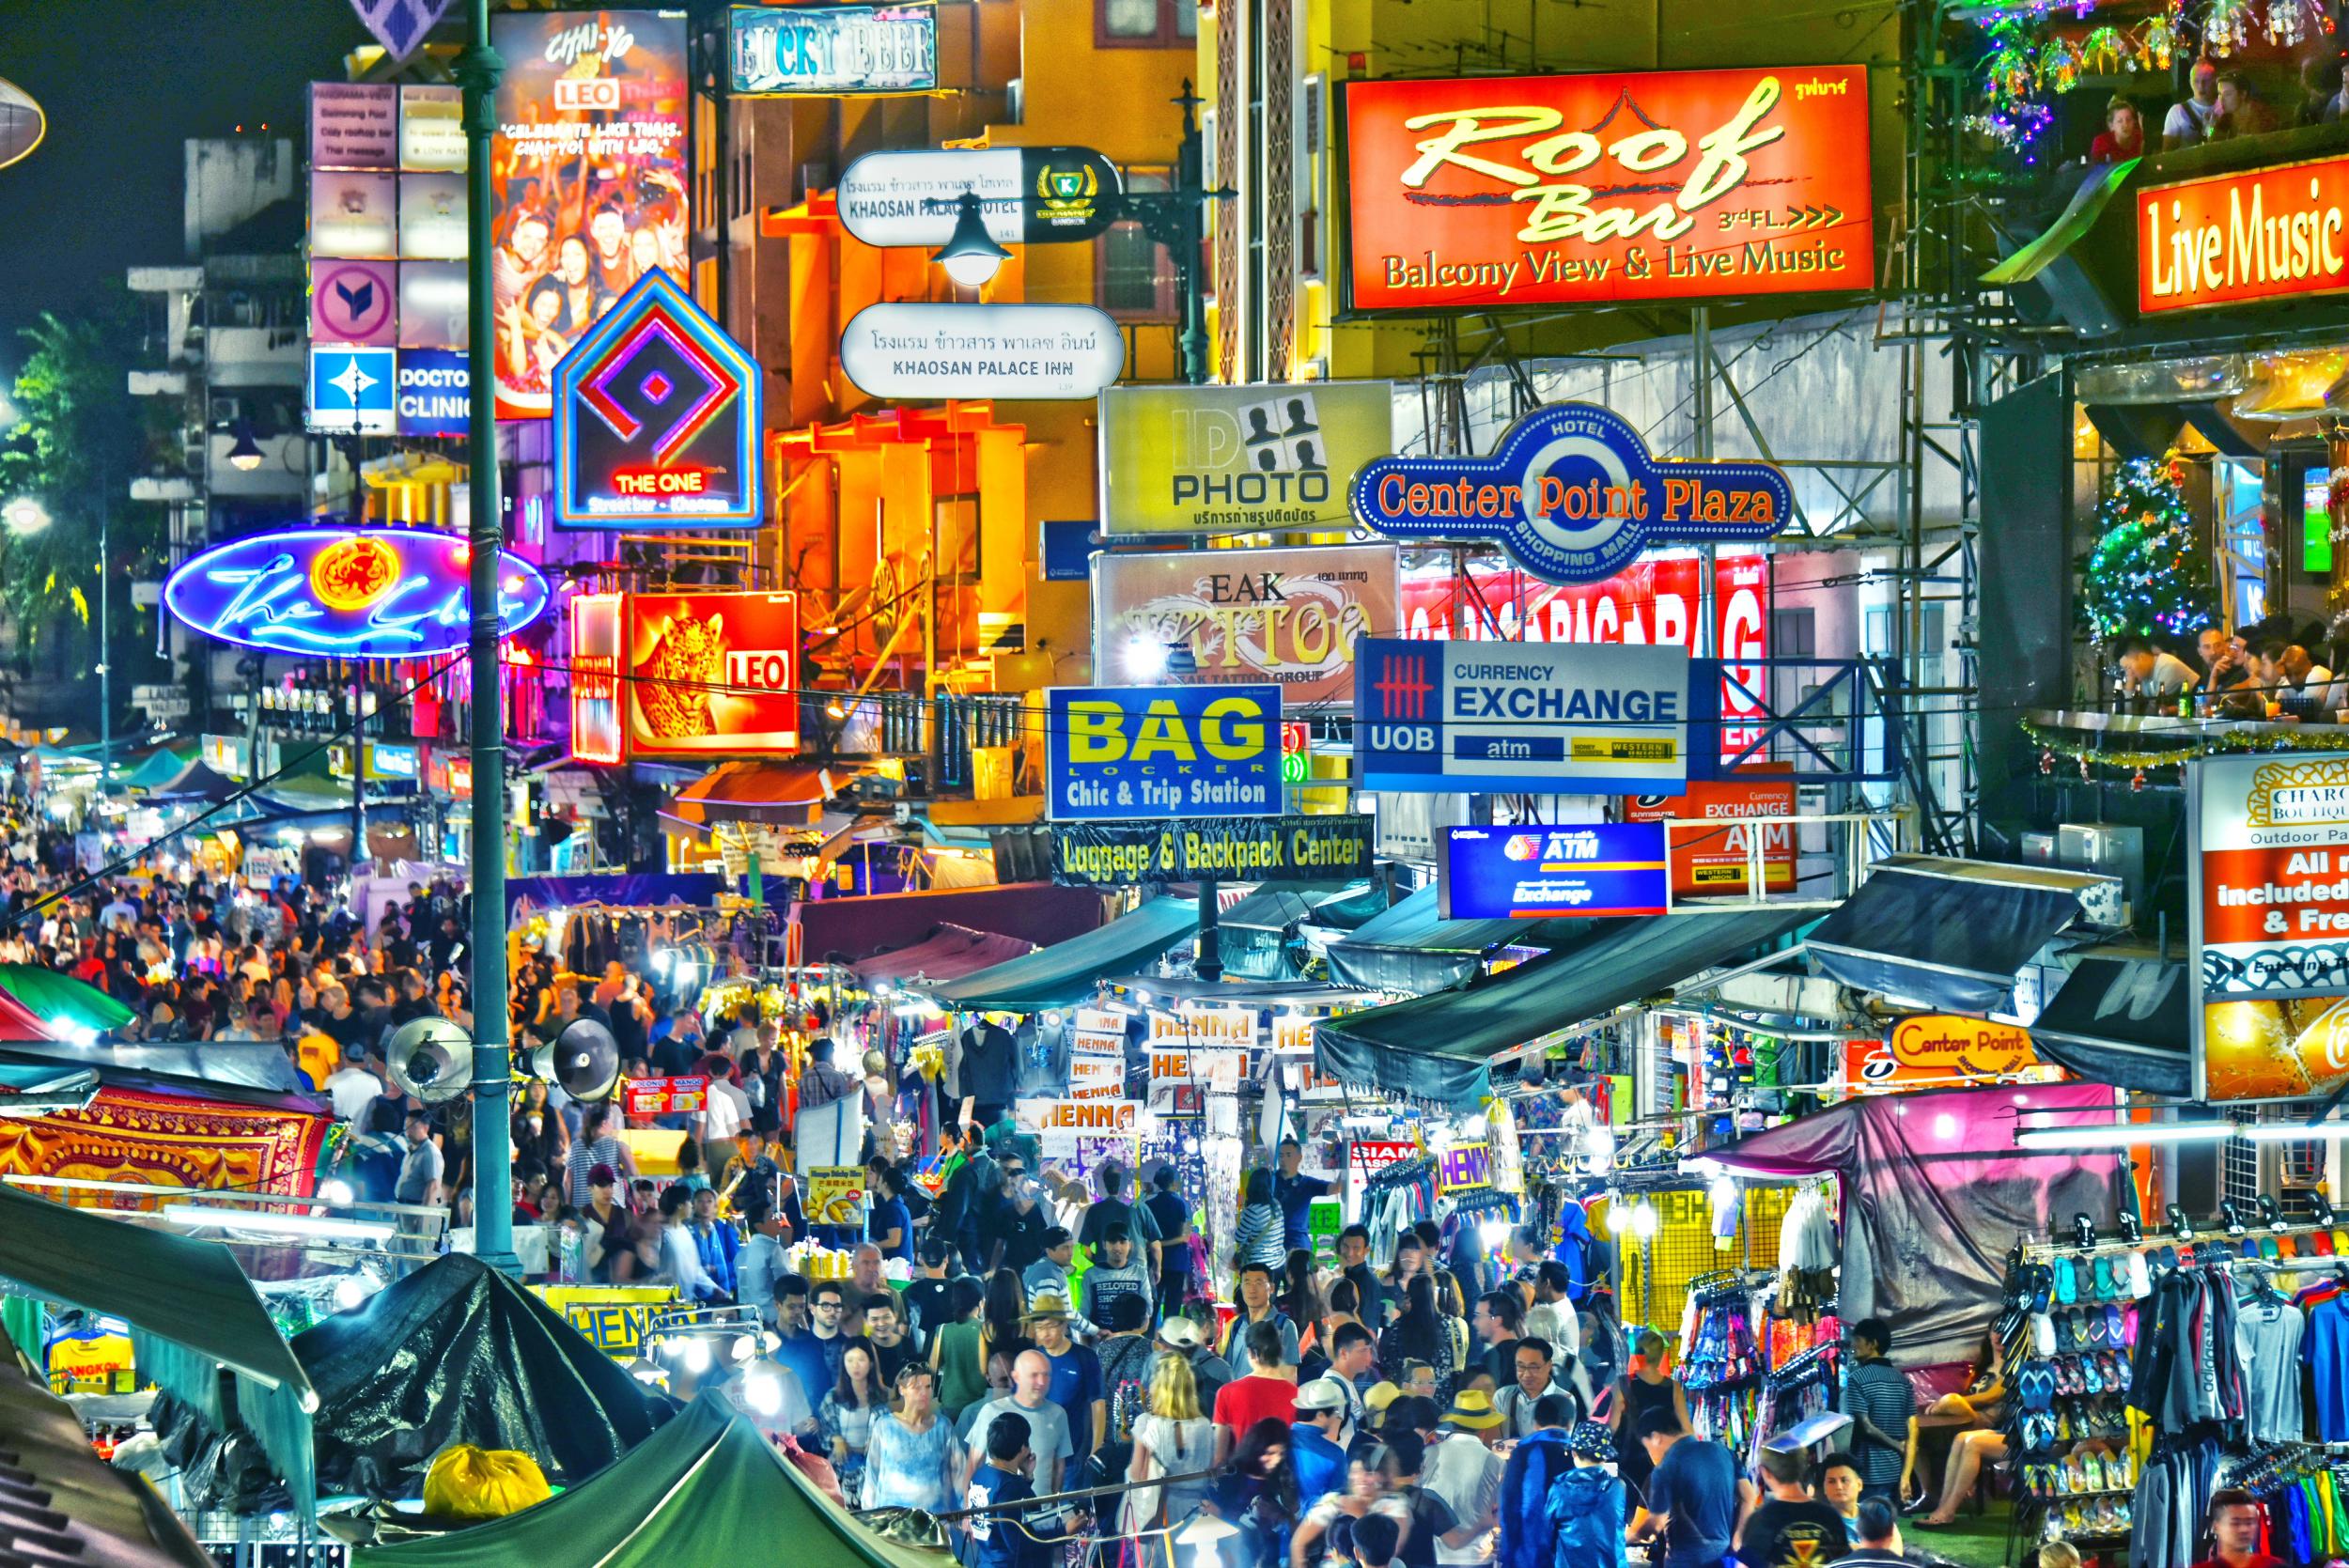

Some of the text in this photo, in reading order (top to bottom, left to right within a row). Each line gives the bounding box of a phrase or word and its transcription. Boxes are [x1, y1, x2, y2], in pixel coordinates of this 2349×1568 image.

[545, 23, 634, 65] CHAI-YO
[735, 23, 933, 77] LUCKY BEER
[560, 84, 614, 104] LEO
[596, 123, 630, 137] LIKE
[588, 140, 624, 155] WITH
[1401, 76, 1784, 211] Roof
[1061, 179, 1073, 193] K
[849, 200, 914, 218] KHAOSAN
[1513, 185, 1695, 244] Bar
[2148, 178, 2344, 297] Live Music
[1383, 240, 1844, 294] Balcony View & Live Music
[871, 331, 927, 350] โรงแรม
[935, 331, 995, 350] ข้าวสาร
[400, 368, 470, 387] DOCTO
[894, 361, 1073, 376] KHAOSAN PALACE INN
[1550, 419, 1606, 439] HOTEL
[615, 473, 703, 493] THE ONE
[1173, 471, 1330, 505] PHOTO
[1378, 474, 1774, 523] Center Point Plaza
[1516, 520, 1641, 567] SHOPPING MALL
[207, 554, 324, 633] The
[1209, 572, 1287, 602] EAK
[731, 655, 786, 690] LEO
[1209, 674, 1270, 684] TATTOO
[1273, 671, 1324, 683] GROUP
[1455, 663, 1554, 681] CURRENCY
[1454, 686, 1677, 721] EXCHANGE
[1068, 697, 1265, 763] BAG
[1371, 725, 1435, 751] UOB
[1487, 740, 1531, 758] atm
[1068, 764, 1265, 777] LOCKER
[1066, 777, 1266, 811] Chic & Trip Station
[1750, 792, 1788, 801] Currency
[1705, 802, 1789, 818] EXCHANGE
[1724, 824, 1790, 851] AM
[2251, 832, 2320, 845] Outdoor
[1063, 829, 1363, 882] Luggage & Backpack Center
[1543, 839, 1598, 859] ATM
[2286, 851, 2329, 875] All
[1513, 886, 1593, 905] Exchange
[2217, 878, 2349, 907] included
[2263, 910, 2289, 933] &
[2254, 958, 2328, 974] Entering
[1155, 1015, 1249, 1039] HENNA
[1077, 1038, 1115, 1051] HENNA
[1900, 1025, 2024, 1056] Center Point
[1073, 1063, 1122, 1077] HENA
[1072, 1083, 1121, 1099] HENNA
[1352, 1147, 1420, 1158] SIAM
[1097, 1281, 1139, 1291] BELOVED
[2201, 1339, 2215, 1392] adidas
